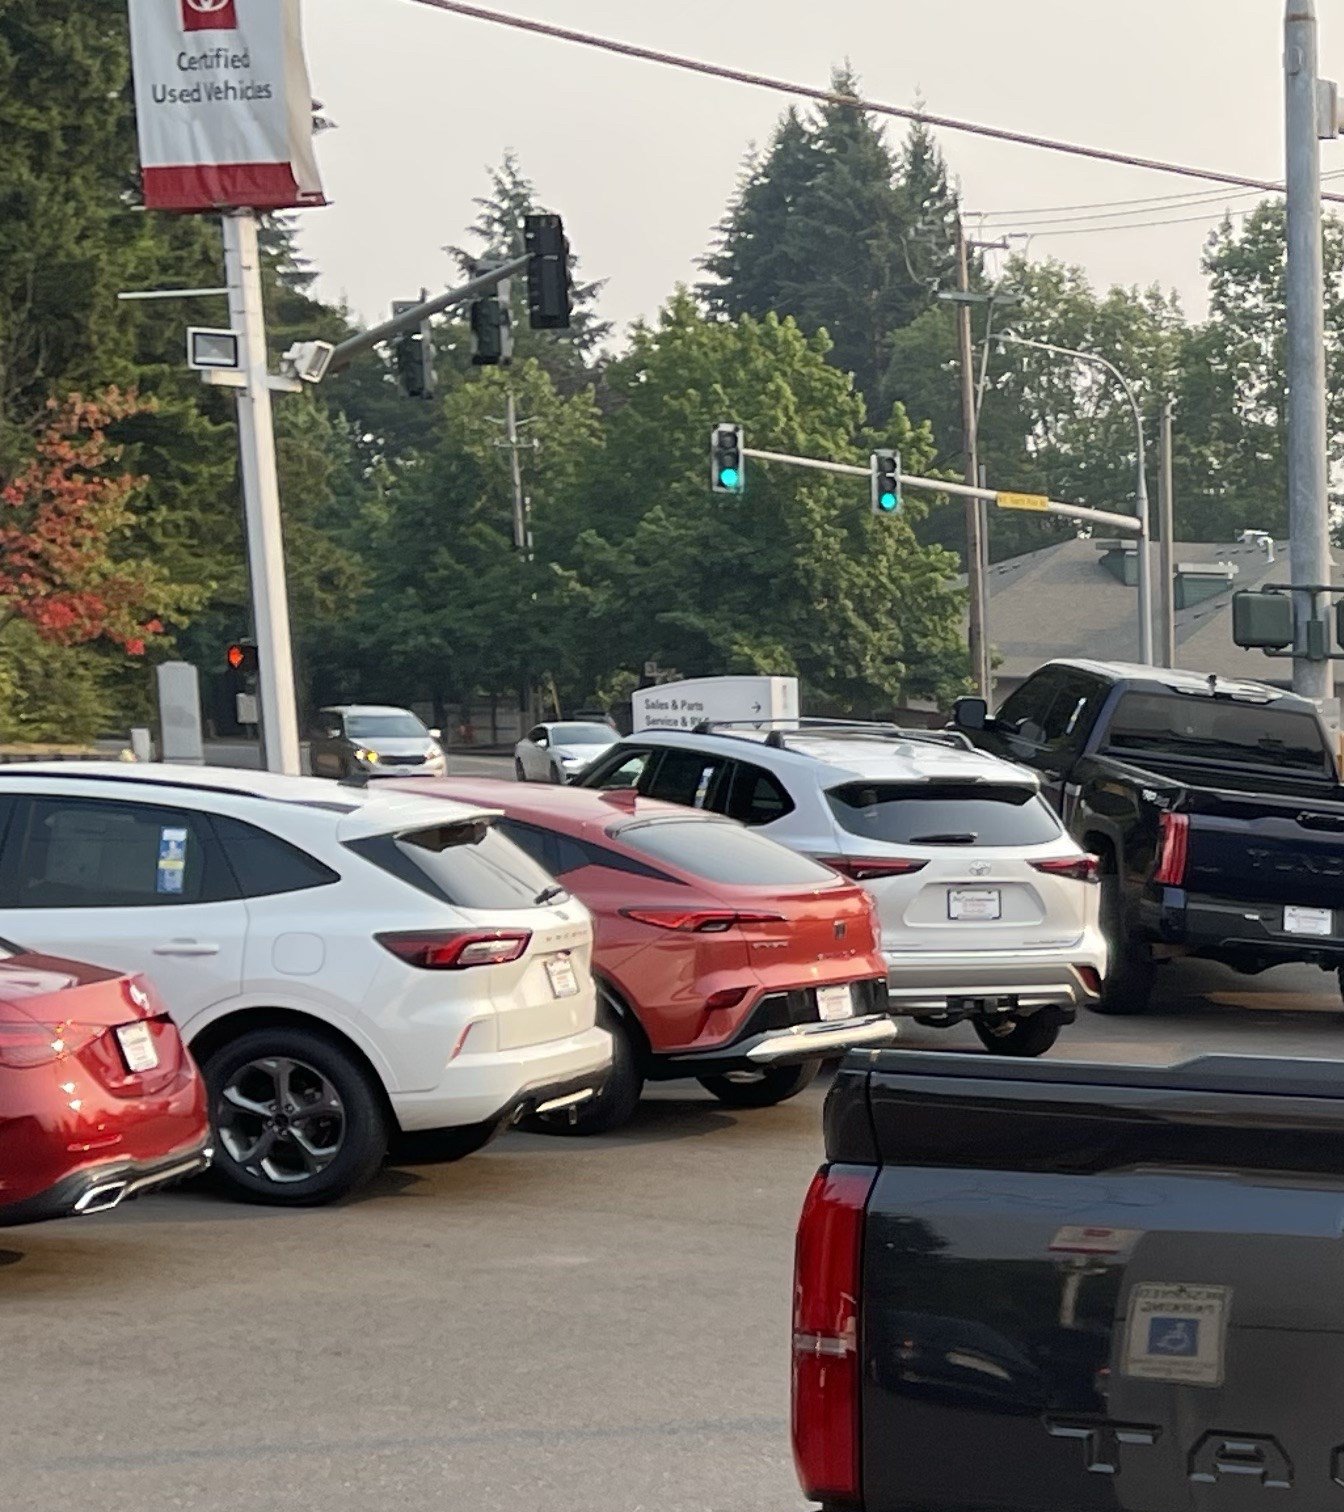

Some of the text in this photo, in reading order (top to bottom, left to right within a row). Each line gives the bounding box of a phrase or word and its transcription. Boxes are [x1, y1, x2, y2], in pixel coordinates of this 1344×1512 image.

[177, 47, 250, 71] Certified
[152, 80, 272, 103] Used Vehicles
[645, 699, 668, 711] Sales
[645, 715, 679, 727] Service
